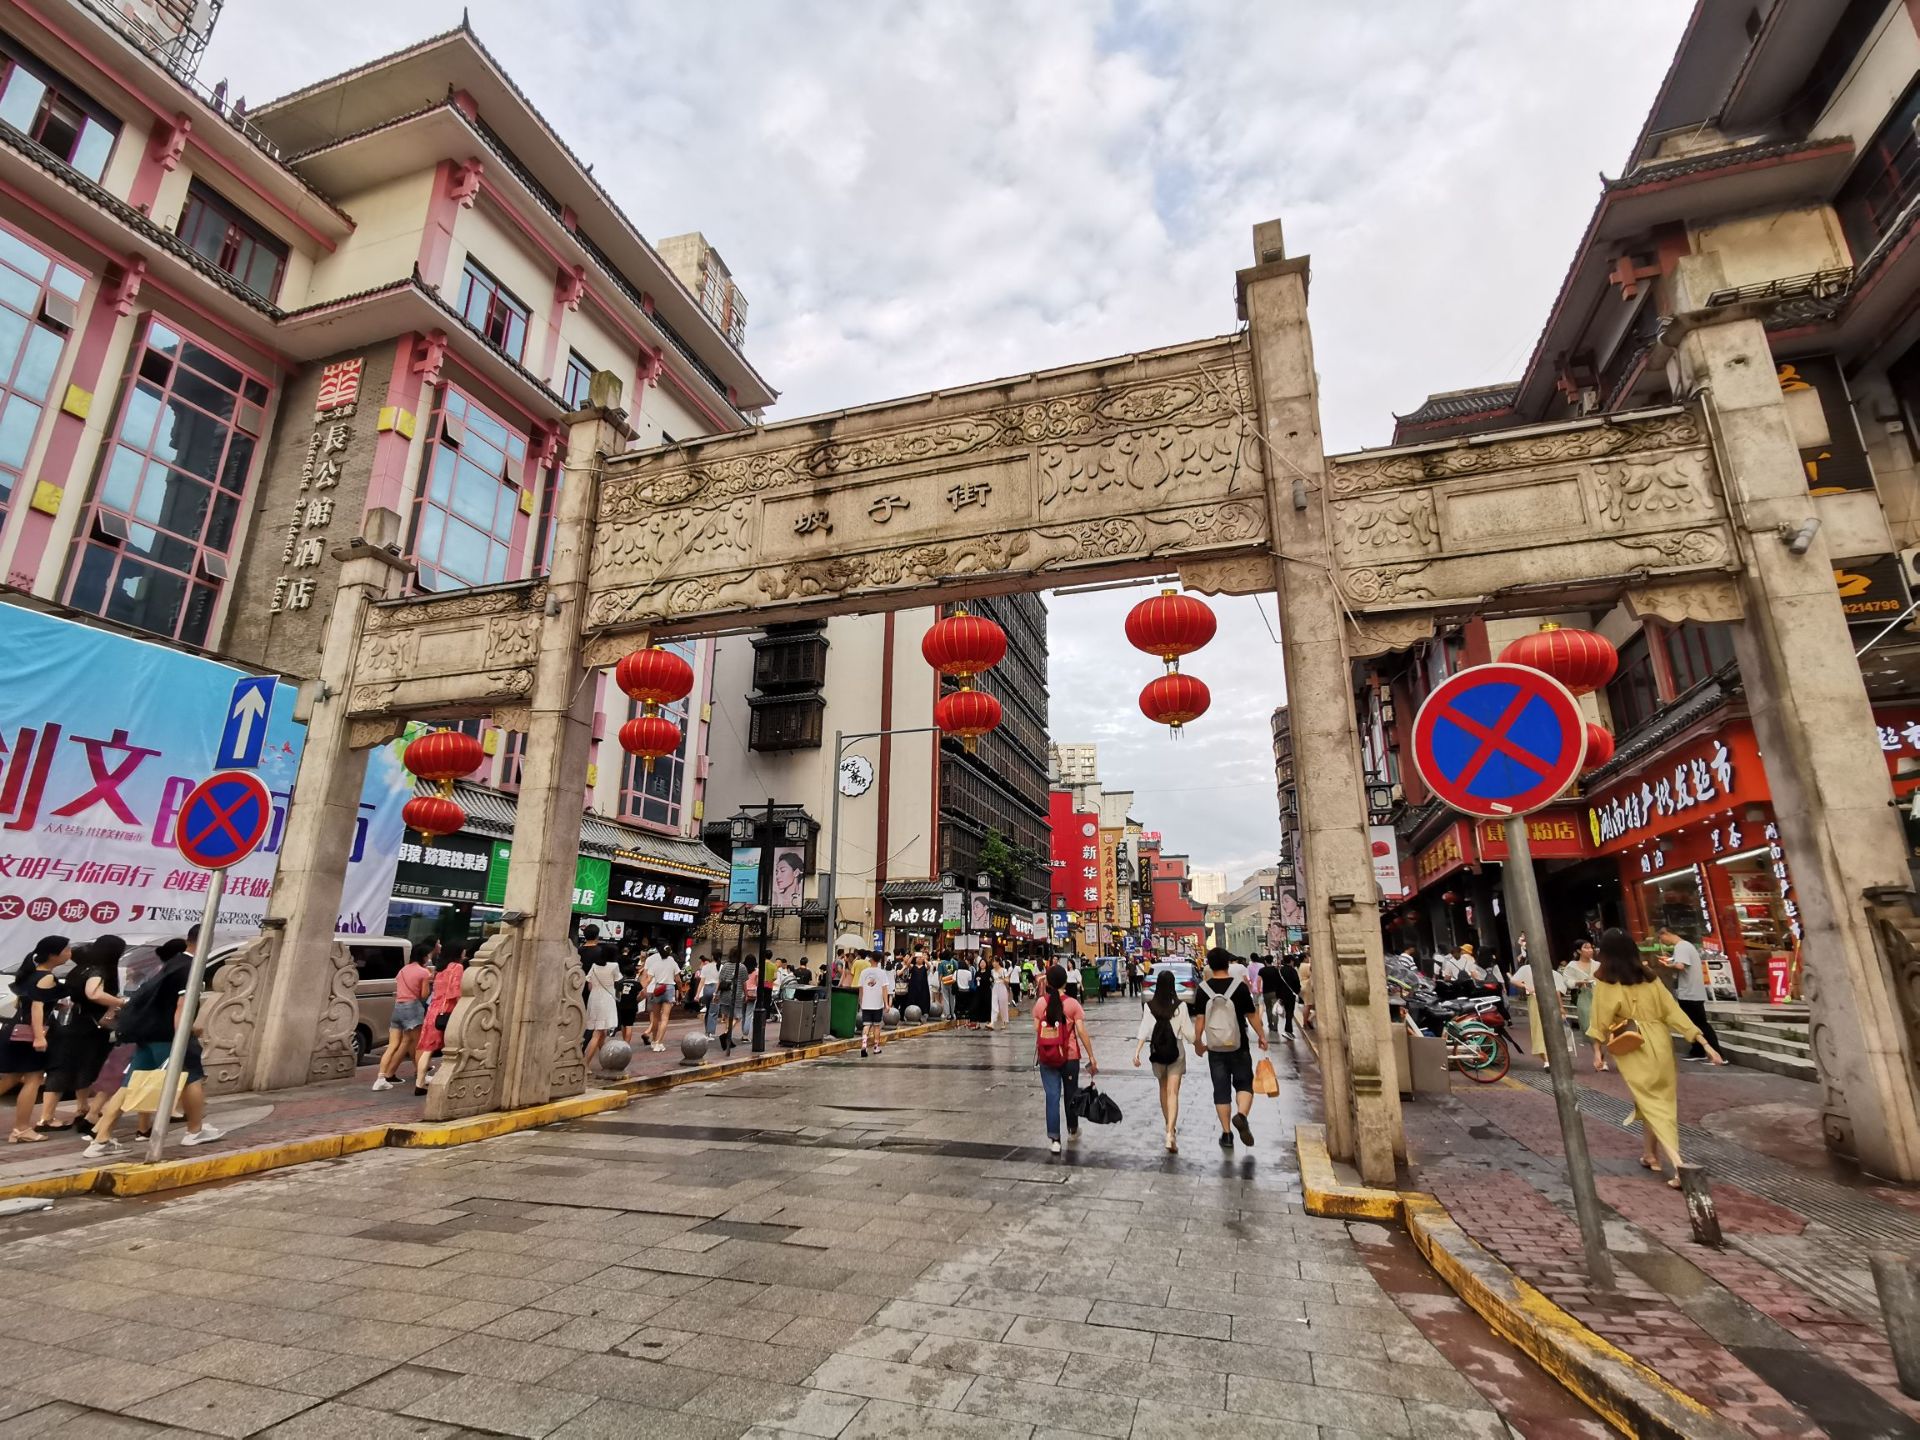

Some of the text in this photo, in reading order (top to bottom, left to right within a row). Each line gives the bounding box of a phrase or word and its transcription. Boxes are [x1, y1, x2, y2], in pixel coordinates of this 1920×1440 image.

[794, 482, 991, 534] 坡子街
[1599, 740, 1731, 842] 湖南特产批发超市
[0, 854, 156, 888] 文明与你同行
[1082, 845, 1098, 901] 新华楼
[178, 908, 249, 919] CONSCTION
